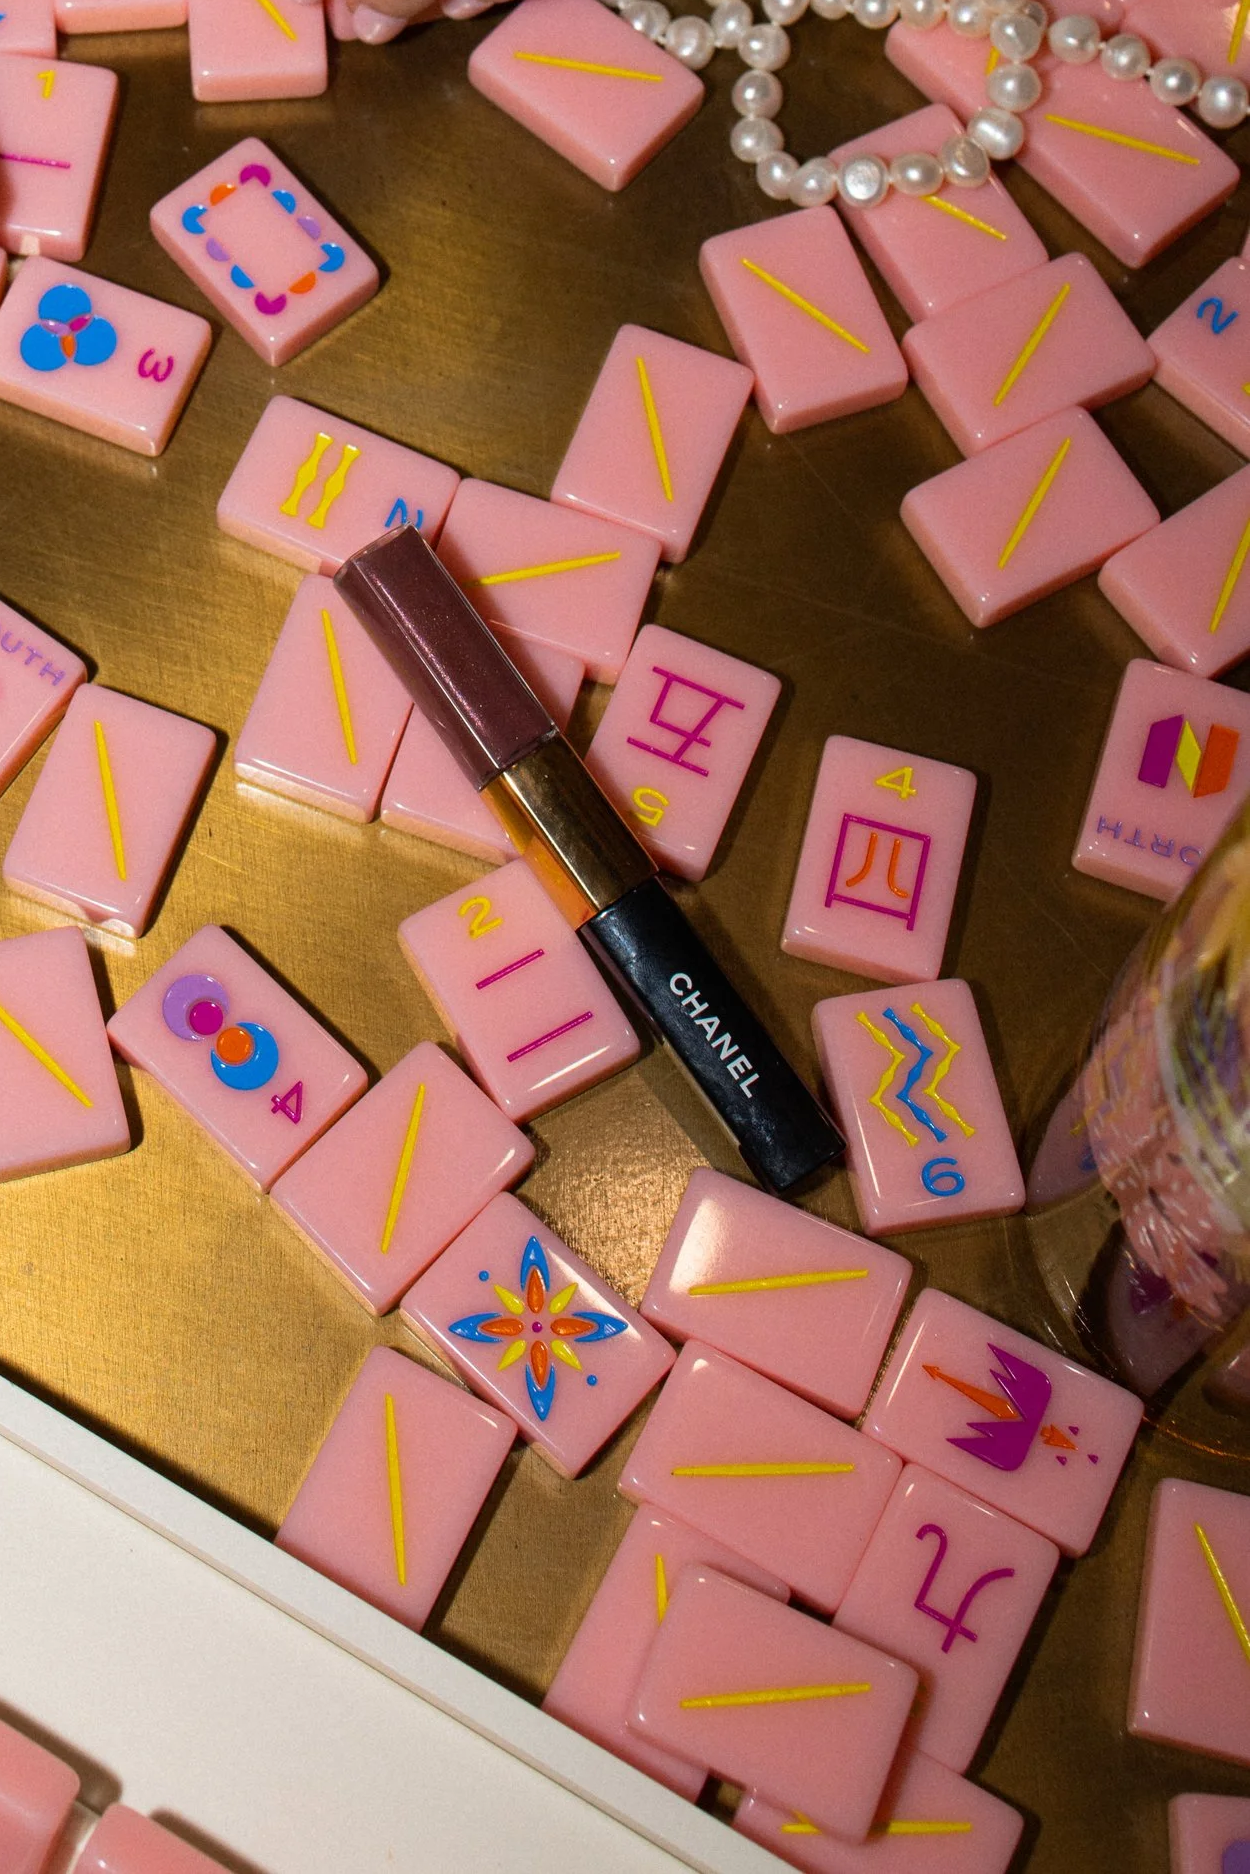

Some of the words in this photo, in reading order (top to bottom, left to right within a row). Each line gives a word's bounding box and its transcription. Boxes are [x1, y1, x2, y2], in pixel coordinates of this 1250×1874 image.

[1196, 297, 1239, 335] 2
[875, 765, 917, 801] 4
[458, 895, 504, 939] 2
[668, 971, 762, 1099] CHANEL
